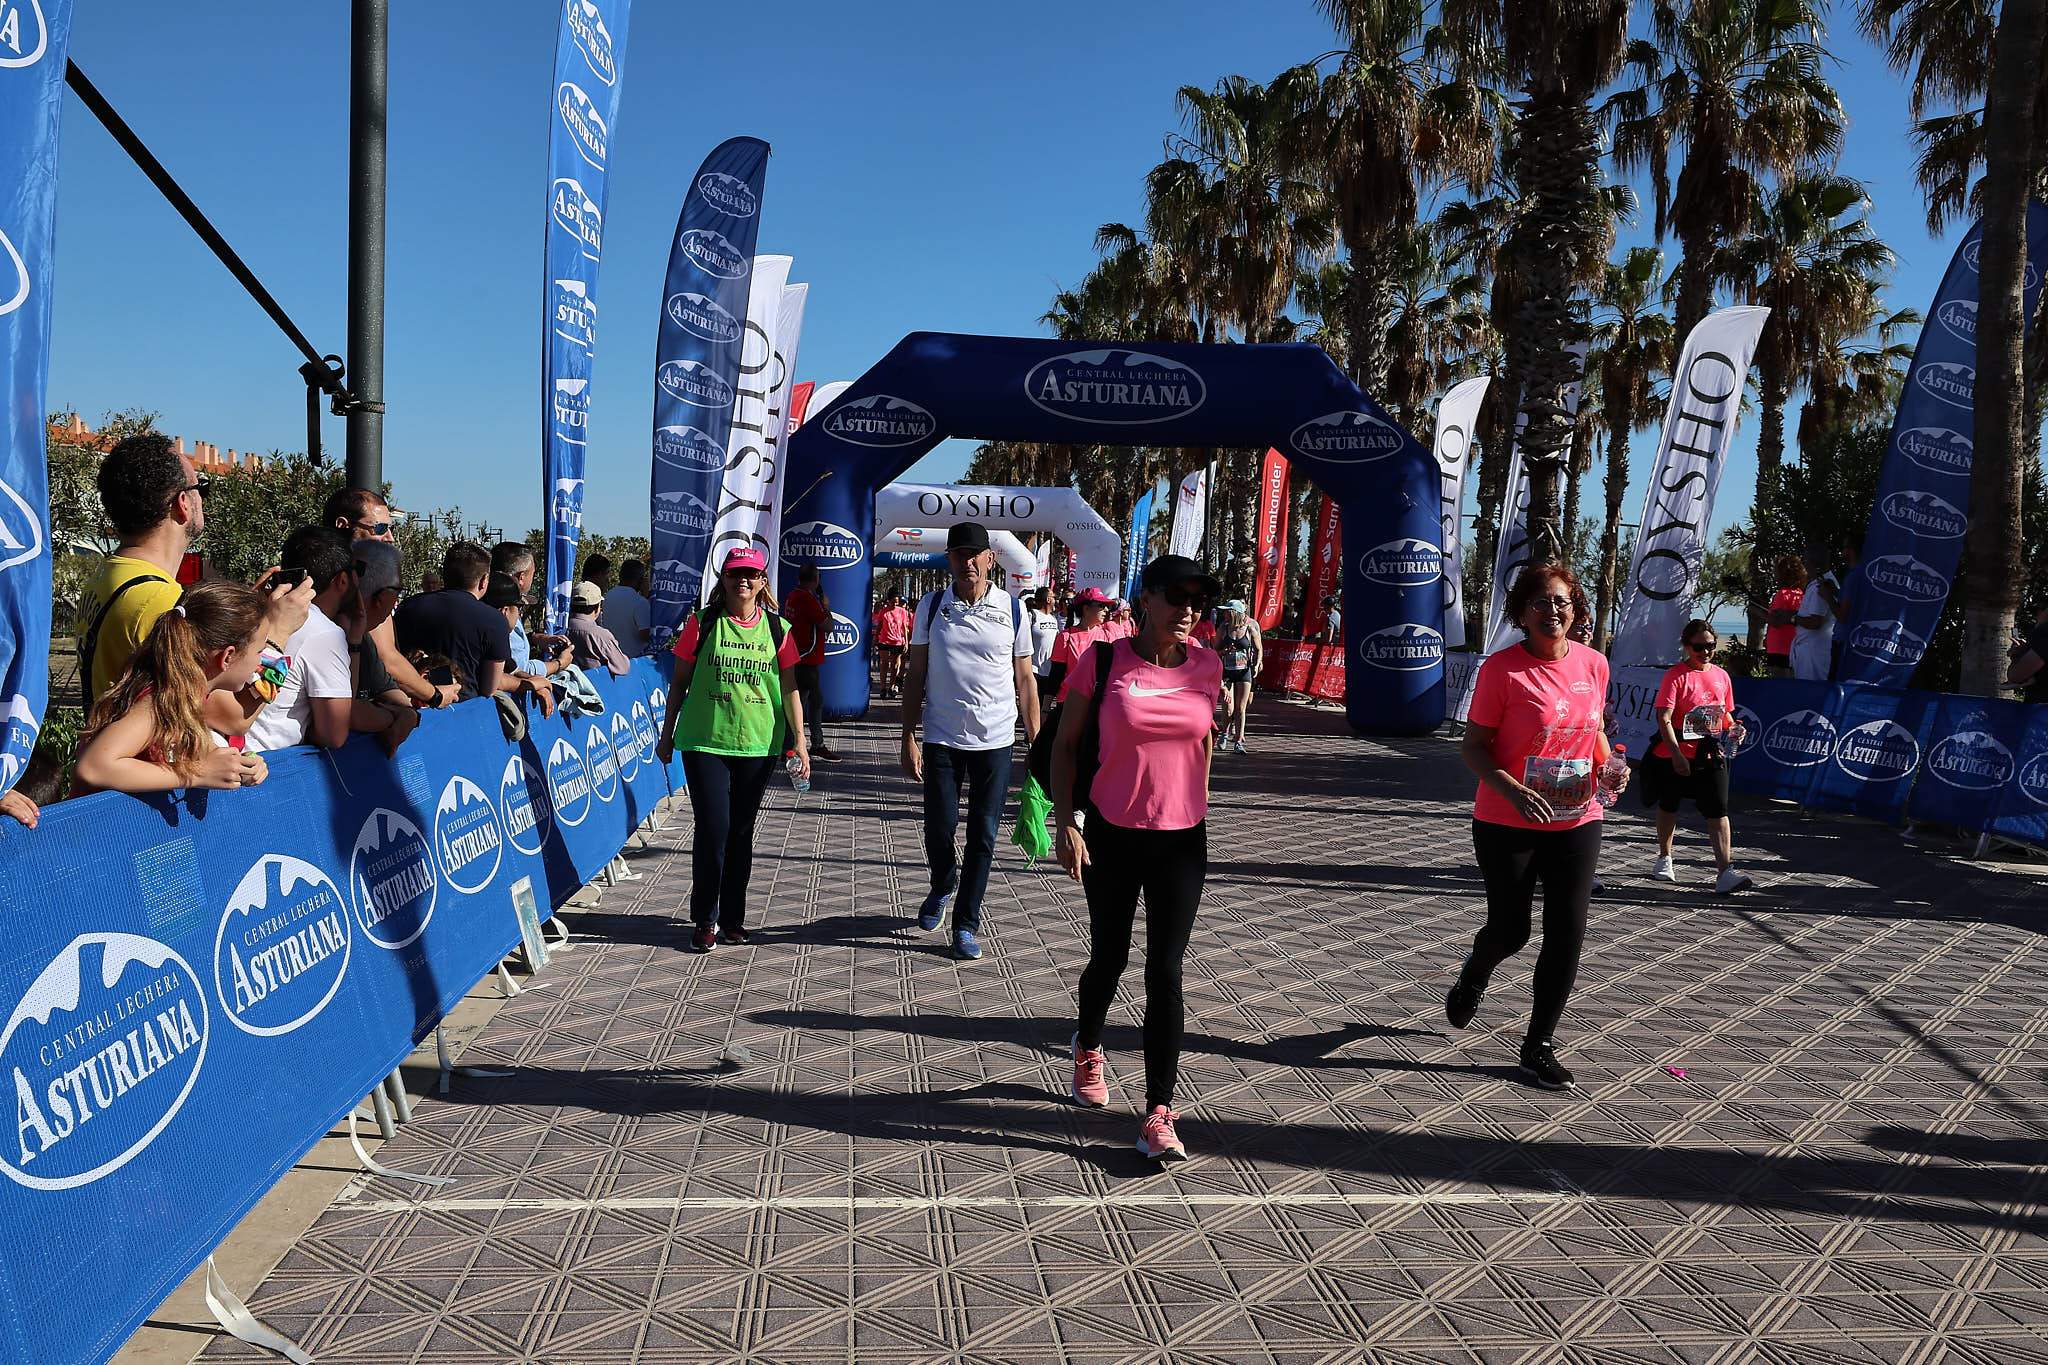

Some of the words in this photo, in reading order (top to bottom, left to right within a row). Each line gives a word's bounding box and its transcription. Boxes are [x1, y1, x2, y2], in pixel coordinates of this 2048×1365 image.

[685, 236, 741, 275] ASTURIANA
[672, 300, 734, 339] ASTURIANA
[662, 368, 728, 404] ASTURIANA
[1039, 369, 1192, 406] ASTURIANA
[1067, 369, 1124, 379] CENTRAL
[1129, 371, 1186, 381] LECHERA
[1921, 369, 1974, 399] ASTURI
[829, 413, 926, 435] ASTURIANA
[1300, 431, 1398, 450] ASTURIANA
[656, 434, 721, 467] ASTURIANA
[711, 319, 769, 580] OYSHO
[1903, 434, 1972, 469] ASTURIAN
[1636, 351, 1738, 602] OYSHO
[655, 510, 713, 530] STURIANA
[918, 492, 1035, 519] OYSHO
[1266, 463, 1282, 544] Santander
[1887, 499, 1960, 534] ASTURIANA
[1067, 521, 1101, 531] OYSHO
[781, 538, 857, 559] ASTURIANA
[1366, 557, 1440, 574] ASTURIANA
[1083, 571, 1116, 580] OYSHO
[1265, 567, 1279, 618] Sports
[1366, 641, 1441, 659] ASTURIANA
[1447, 662, 1479, 691] SHO
[1767, 728, 1830, 756] ASTURIANA
[1840, 738, 1911, 771] ASTURIANA
[552, 774, 590, 810] ASTURIANA
[447, 818, 469, 834] CENTRAL
[506, 796, 548, 838] ASTURIANA
[441, 820, 499, 875] ASTURIANA
[367, 854, 394, 878] CENTRAL
[360, 857, 434, 930] ASTURIANA
[244, 914, 290, 947] CENTRAL
[290, 890, 332, 921] LECHERA
[230, 911, 346, 1015] ASTURIANA
[40, 1010, 116, 1066] CENTRAL
[116, 972, 180, 1020] LECHERA
[13, 998, 200, 1165] ASTURIANA
